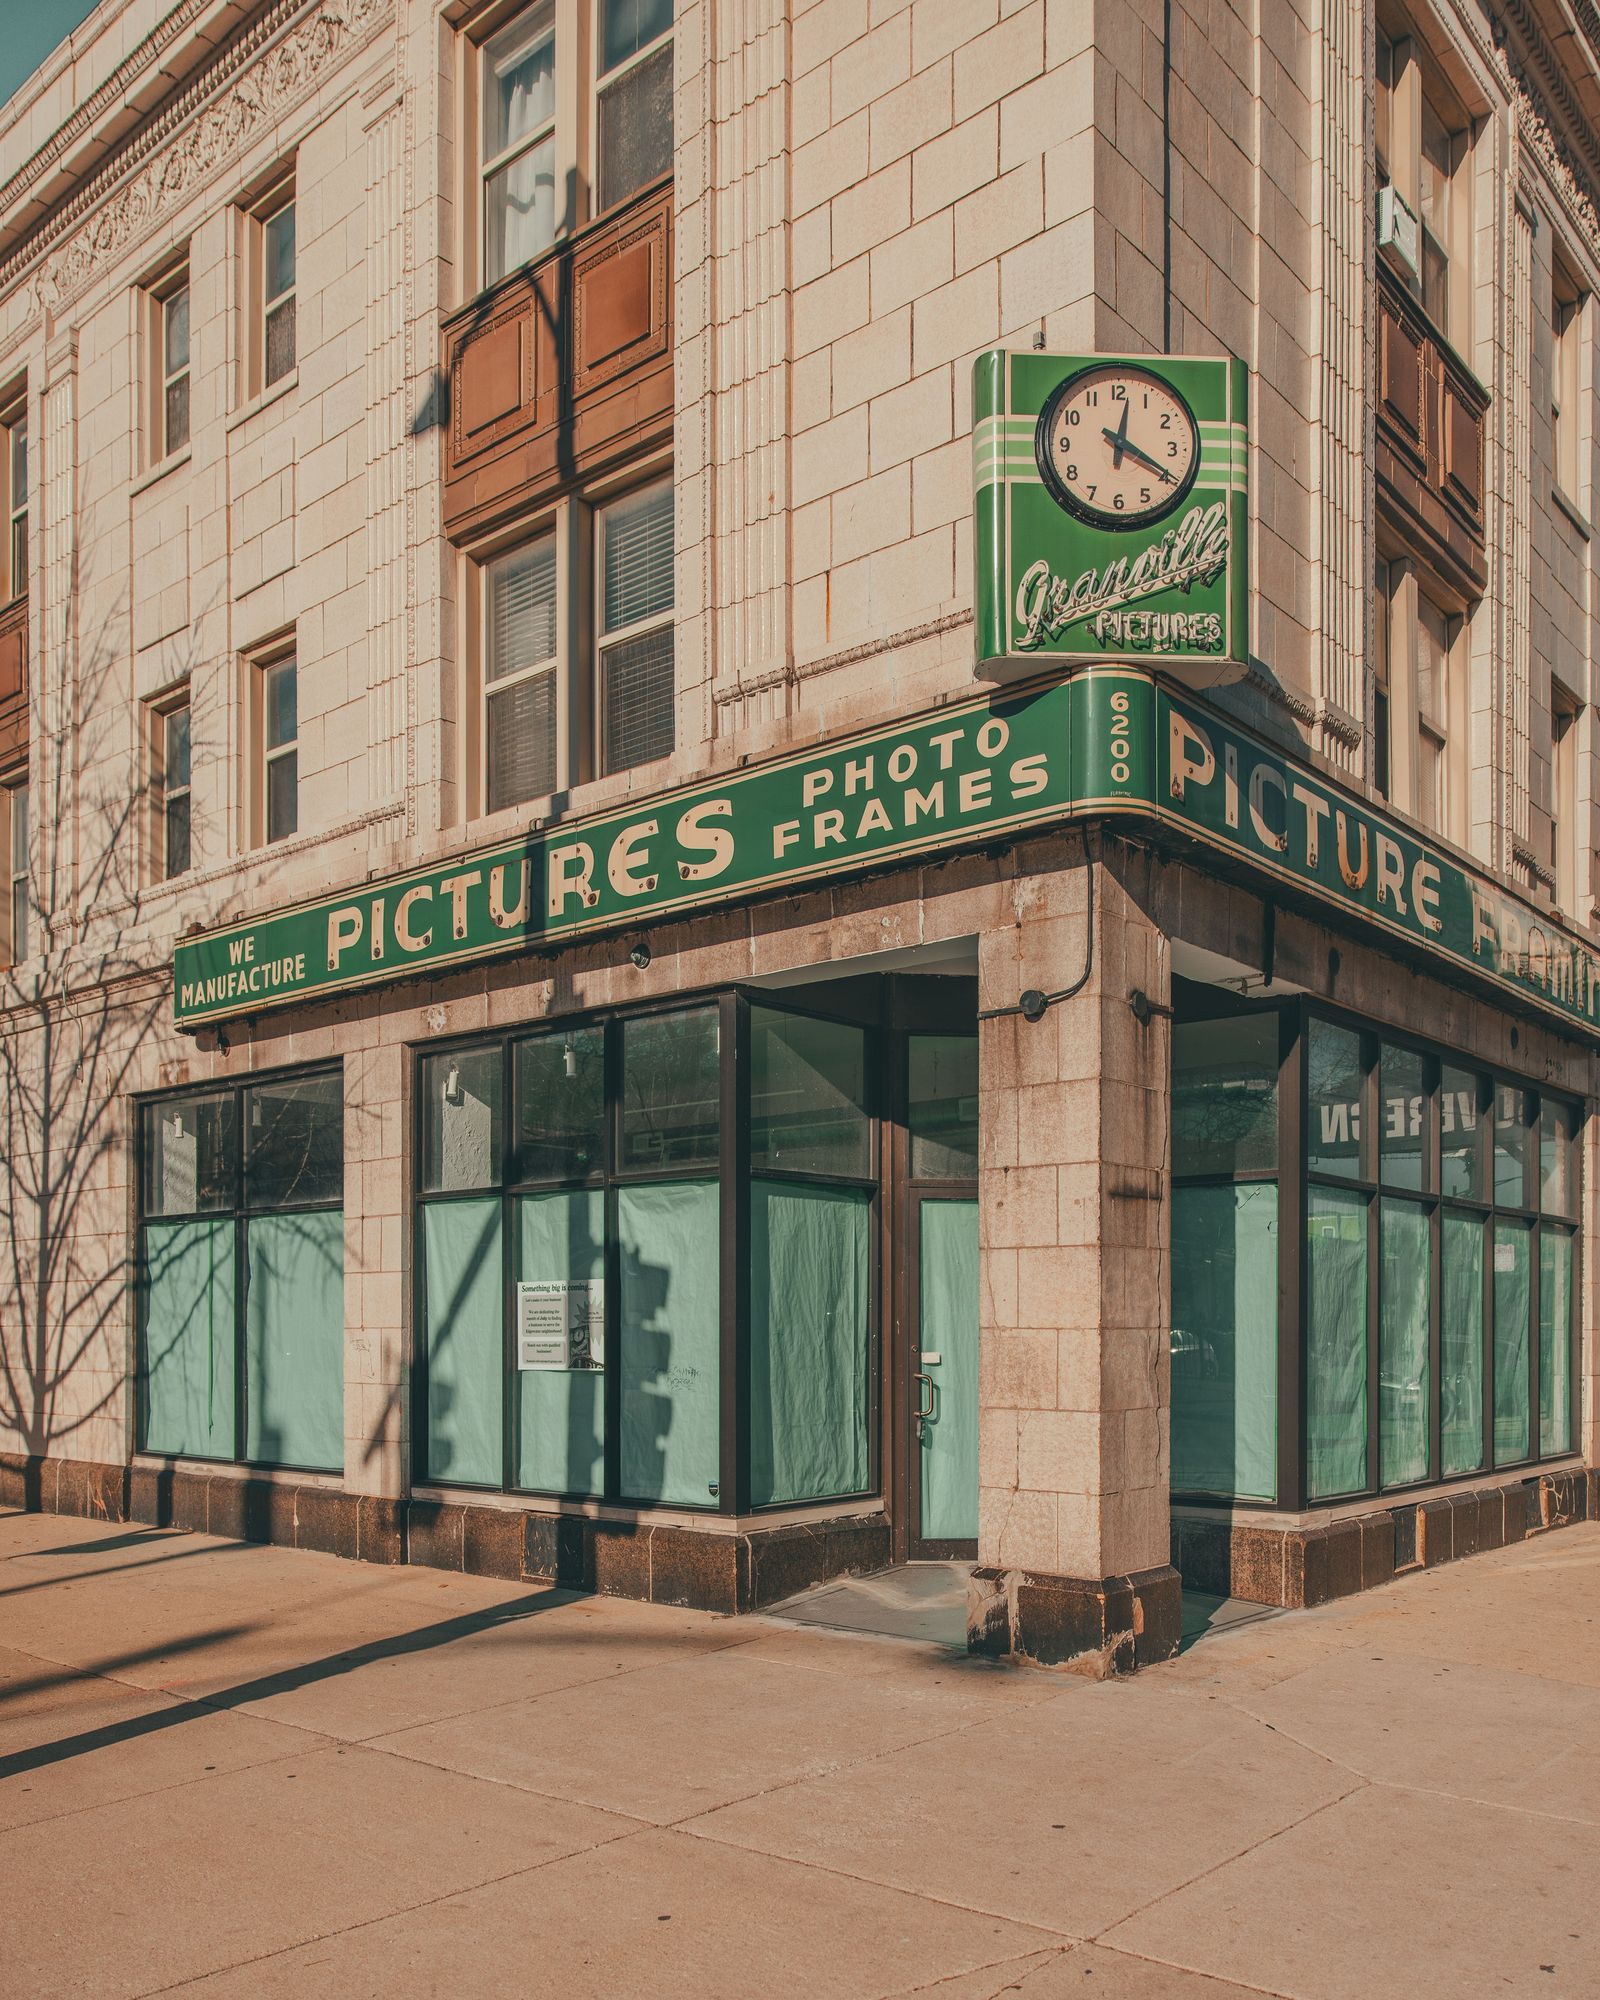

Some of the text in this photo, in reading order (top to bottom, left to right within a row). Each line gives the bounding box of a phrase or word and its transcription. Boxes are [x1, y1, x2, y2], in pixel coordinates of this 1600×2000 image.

[1086, 390, 1098, 407] 11
[1111, 384, 1126, 401] 12
[1143, 393, 1148, 409] 1
[1064, 409, 1081, 426] 10
[1159, 413, 1171, 430] 2
[1059, 436, 1071, 453] 9
[1166, 441, 1178, 457] 3
[1065, 464, 1079, 481] 8
[1086, 485, 1098, 502] 7
[1112, 493, 1125, 510] 6
[1139, 487, 1151, 504] 5
[1015, 501, 1228, 646] Granville
[1096, 610, 1222, 642] PICTURES
[1110, 691, 1131, 783] 6200
[803, 717, 1010, 808] PHOTO
[773, 754, 1049, 859] FRAMES
[1170, 709, 1442, 933] PICTURE
[327, 799, 735, 971] PICTURES
[229, 935, 255, 964] WE
[181, 952, 305, 1008] MANUFACTURE
[521, 1284, 551, 1294] Something
[551, 1284, 561, 1293] big
